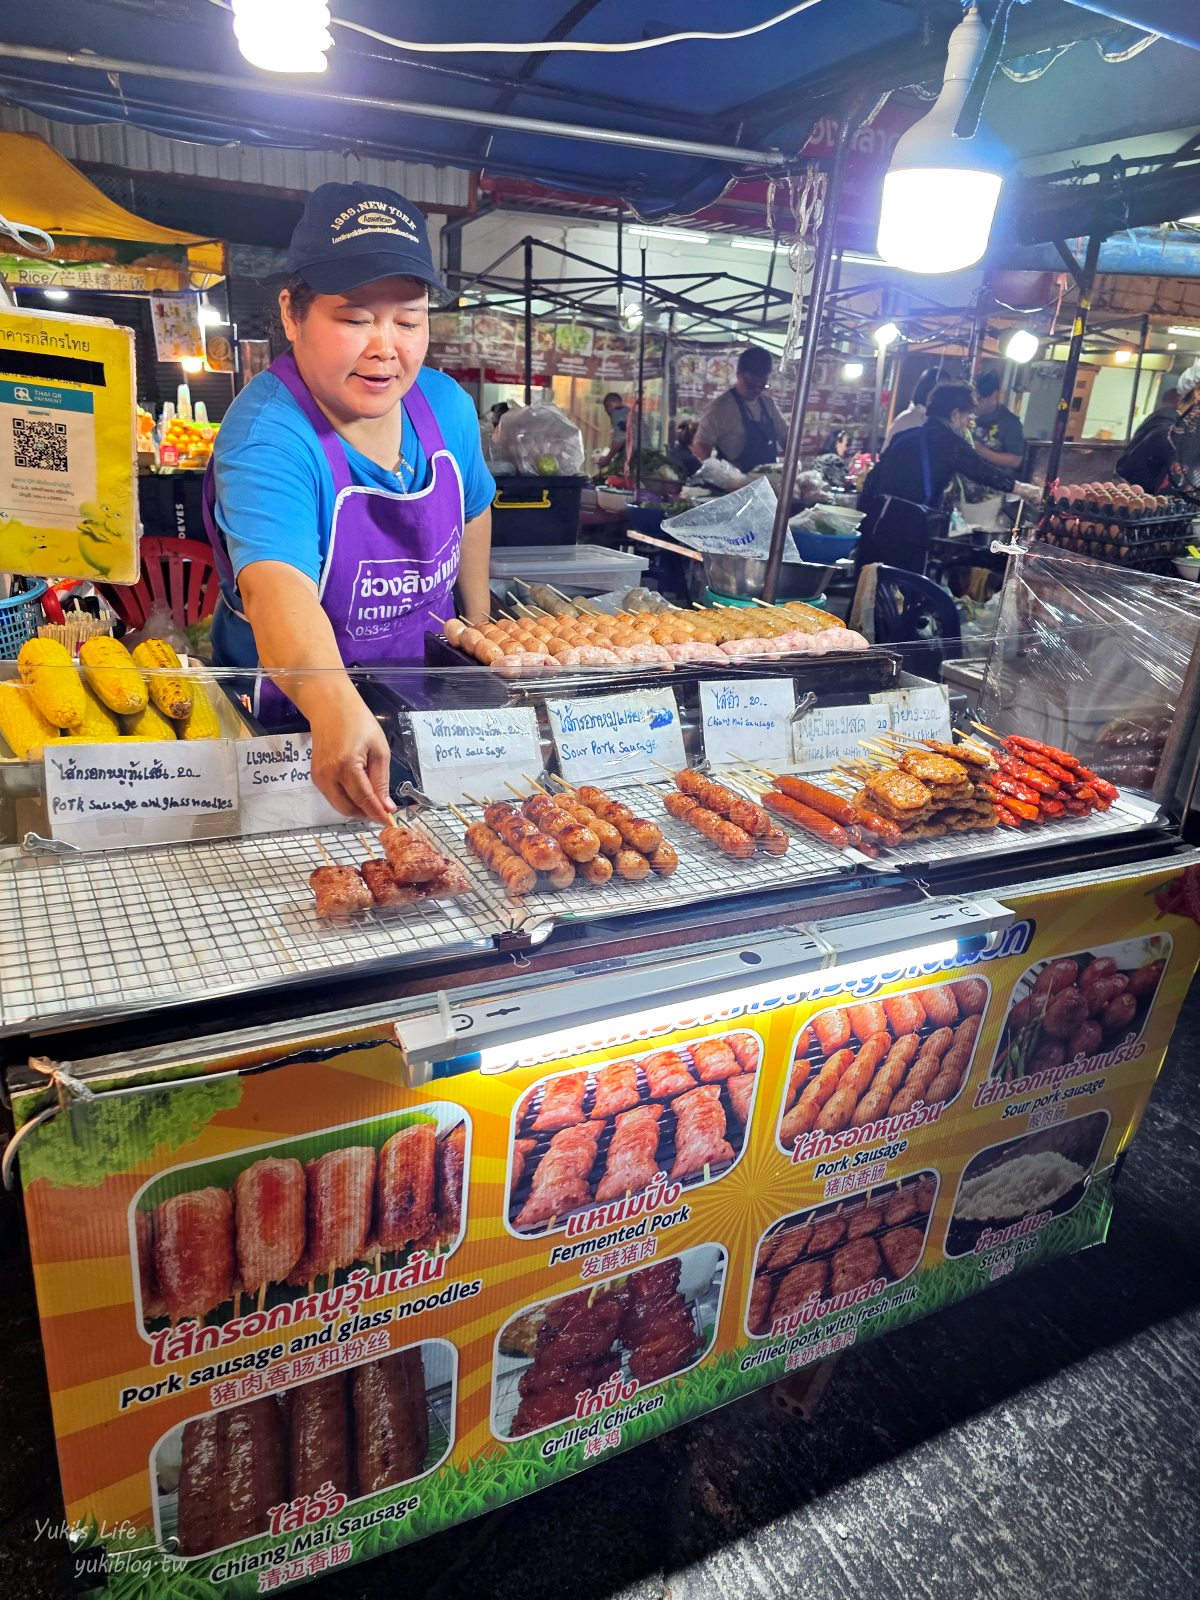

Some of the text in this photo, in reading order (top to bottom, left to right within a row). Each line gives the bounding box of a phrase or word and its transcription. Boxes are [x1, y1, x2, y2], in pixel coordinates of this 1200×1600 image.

[388, 206, 417, 231] YORK
[252, 767, 312, 785] Sour Por
[561, 743, 588, 761] Sour
[591, 740, 615, 756] Pork
[1002, 1078, 1106, 1119] Sour pork sausage
[792, 1101, 944, 1163] ไส้กรอกหมูล้วน
[815, 1140, 908, 1180] Pork Sausage
[825, 1163, 886, 1197] 猪肉香肠
[567, 1172, 681, 1237] แหนมปิ้ง
[549, 1205, 690, 1266] Fermented Pork
[581, 1238, 657, 1280] 发酵猪肉
[978, 1236, 1039, 1270] Sticky Rice
[151, 1252, 447, 1366] ไส้กรอกหมูวุ้นเส้น
[740, 1287, 918, 1372] Grilled pork with fresh milk
[770, 1278, 888, 1338] หมูปิ้งนมสด
[120, 1279, 481, 1411] Pork sausage and glass noodles
[211, 1332, 390, 1406] 猪肉香肠和粉丝
[575, 1371, 639, 1419] ไก่ปิ้ง
[541, 1395, 664, 1457] Grilled Chicken
[584, 1429, 621, 1459] 烤鸡
[269, 1482, 347, 1536] ไส้อั่ว
[210, 1495, 420, 1584] Chiang Mai Sausage
[258, 1540, 352, 1593] 清迈香肠
